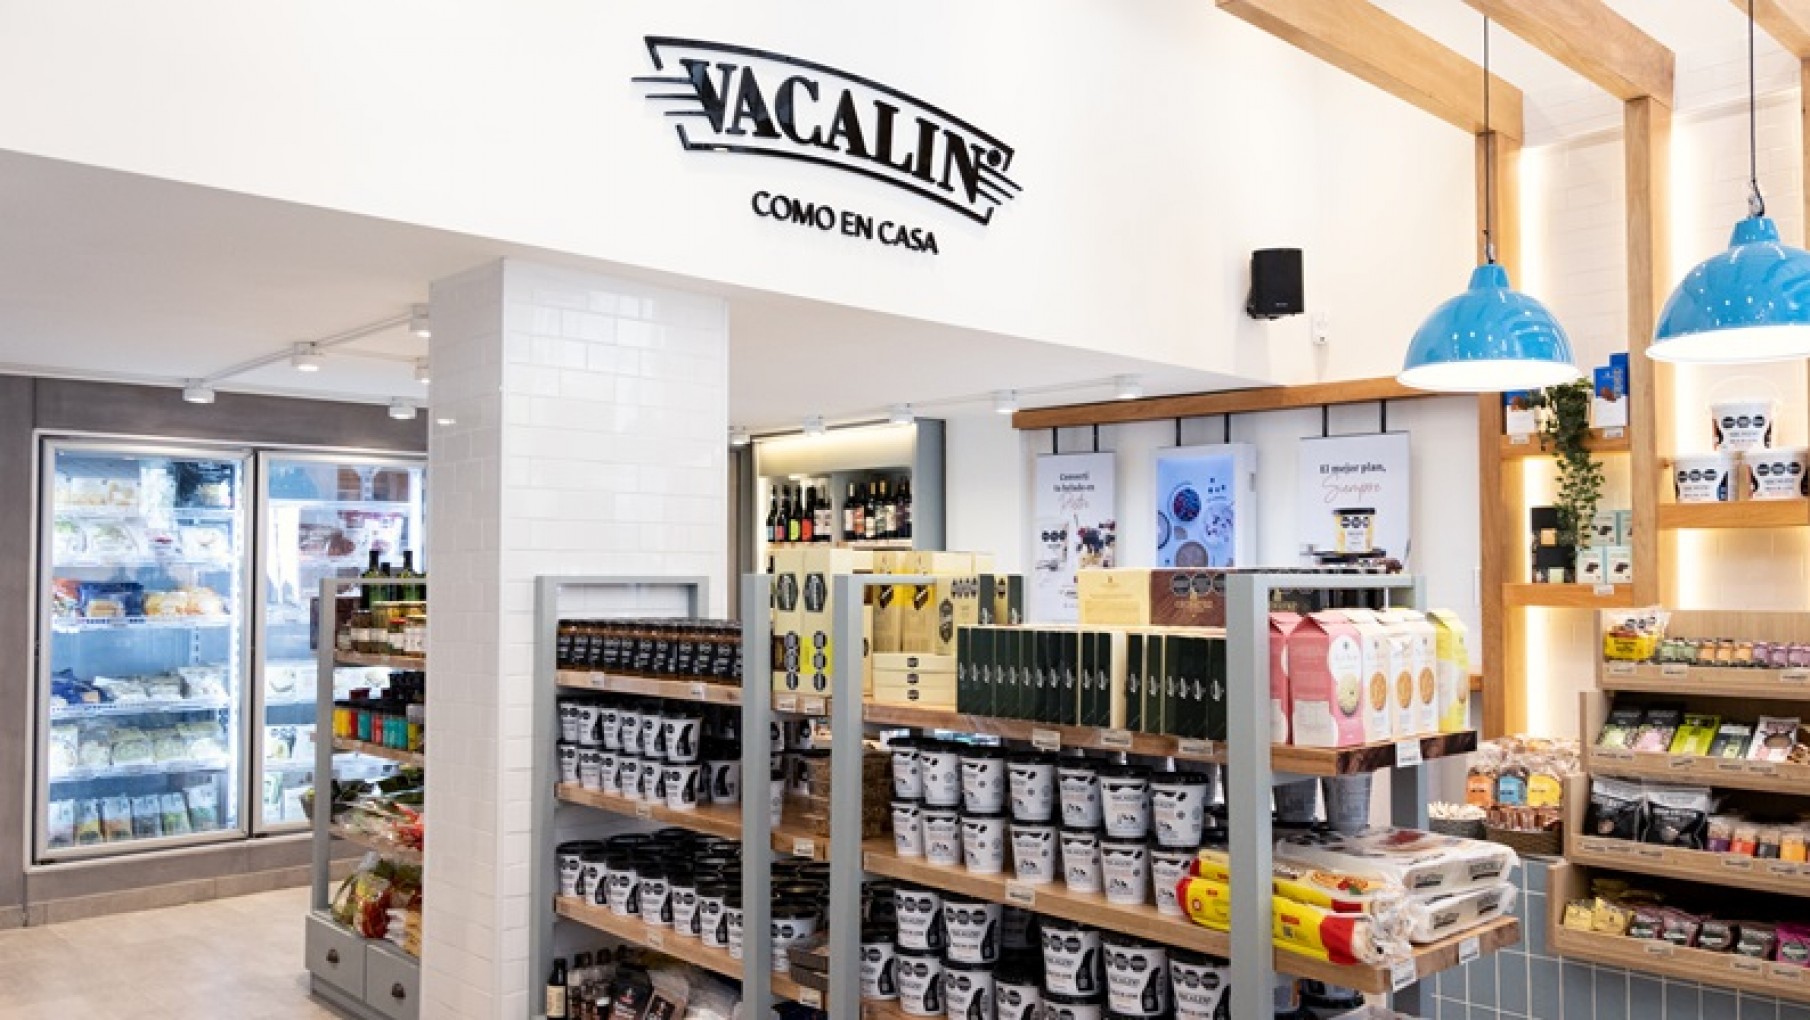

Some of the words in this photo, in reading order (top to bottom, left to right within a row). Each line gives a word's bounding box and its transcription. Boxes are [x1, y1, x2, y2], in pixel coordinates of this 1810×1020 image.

[751, 190, 835, 231] COMO
[841, 210, 873, 240] EN
[878, 220, 939, 255] CASA
